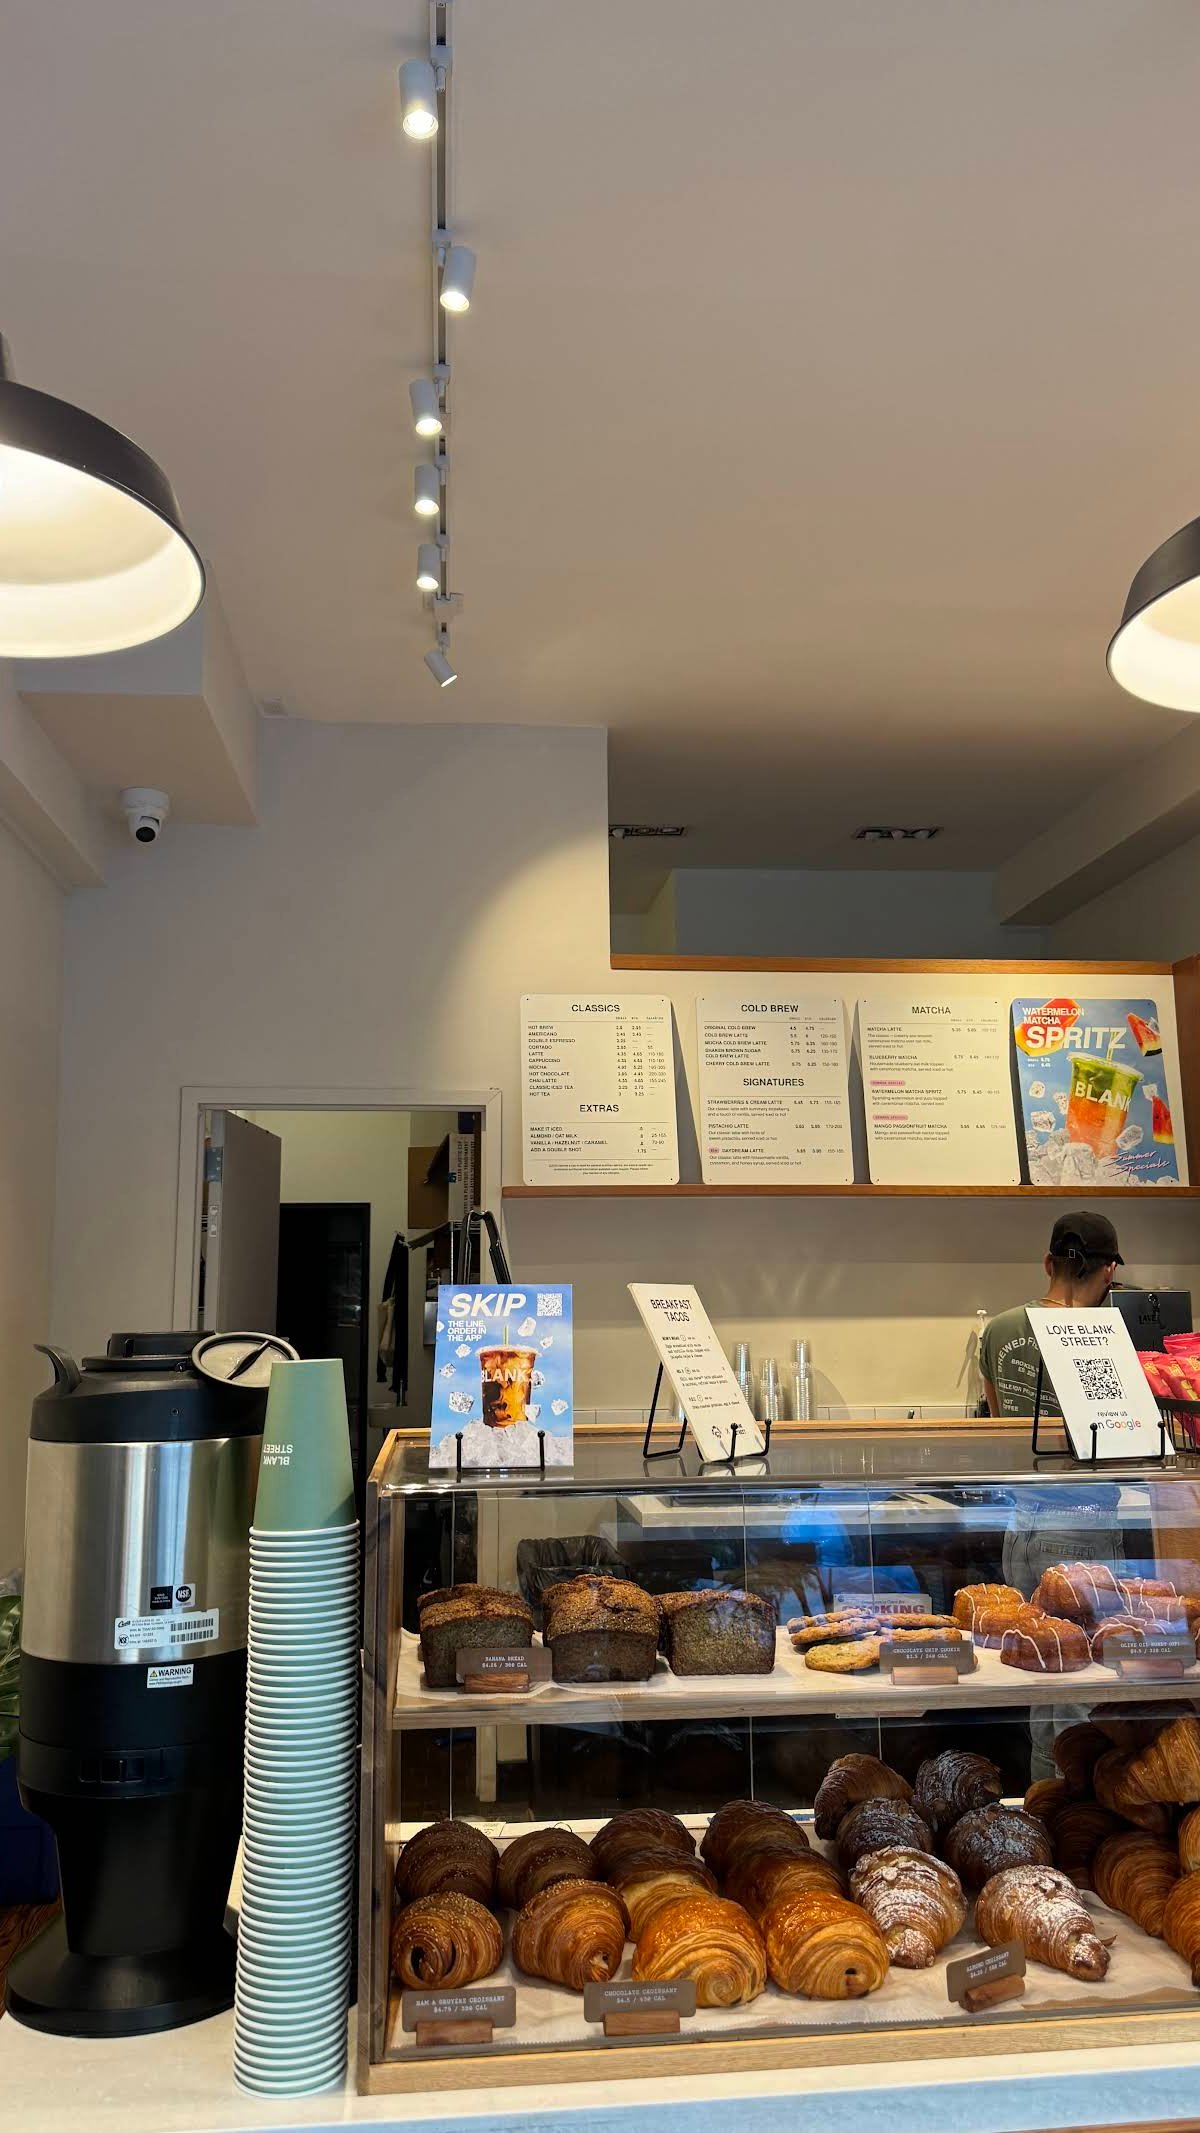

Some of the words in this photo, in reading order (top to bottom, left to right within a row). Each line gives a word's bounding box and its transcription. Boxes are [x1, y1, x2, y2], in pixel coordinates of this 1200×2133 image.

[571, 1004, 621, 1012] CLASSICS
[741, 1004, 768, 1013] COLD
[770, 1004, 799, 1013] BREW
[911, 1006, 952, 1015] MATCHA
[1022, 1007, 1085, 1016] WATERMELON
[1023, 1016, 1061, 1025] MATCHA
[1025, 1026, 1127, 1049] SPRITZ
[743, 1078, 805, 1087] SIGNATURES
[579, 1104, 620, 1112] EXTRAS
[1103, 1150, 1157, 1167] Summer
[1108, 1158, 1170, 1177] Specials
[448, 1293, 527, 1318] SKIP
[650, 1299, 693, 1310] BREAKFAST
[664, 1311, 690, 1322] TACOS
[447, 1327, 478, 1335] ORDER
[478, 1327, 487, 1335] IN
[1046, 1325, 1076, 1335] LOVE
[1077, 1325, 1116, 1335] BLANK
[448, 1334, 464, 1342] THE
[464, 1334, 482, 1342] APP
[1060, 1336, 1109, 1347] STREET?
[480, 1368, 528, 1383] BLANK
[1105, 1418, 1141, 1431] Google
[263, 1443, 294, 1454] STREET
[263, 1455, 290, 1466] BLANK
[177, 1589, 191, 1599] NSF
[158, 1666, 192, 1677] WARNING
[966, 1960, 985, 1973] ALMOND
[985, 1951, 1010, 1965] CROISSANT
[642, 1987, 678, 1995] CROISSANT
[469, 1995, 505, 2003] CROISSANT
